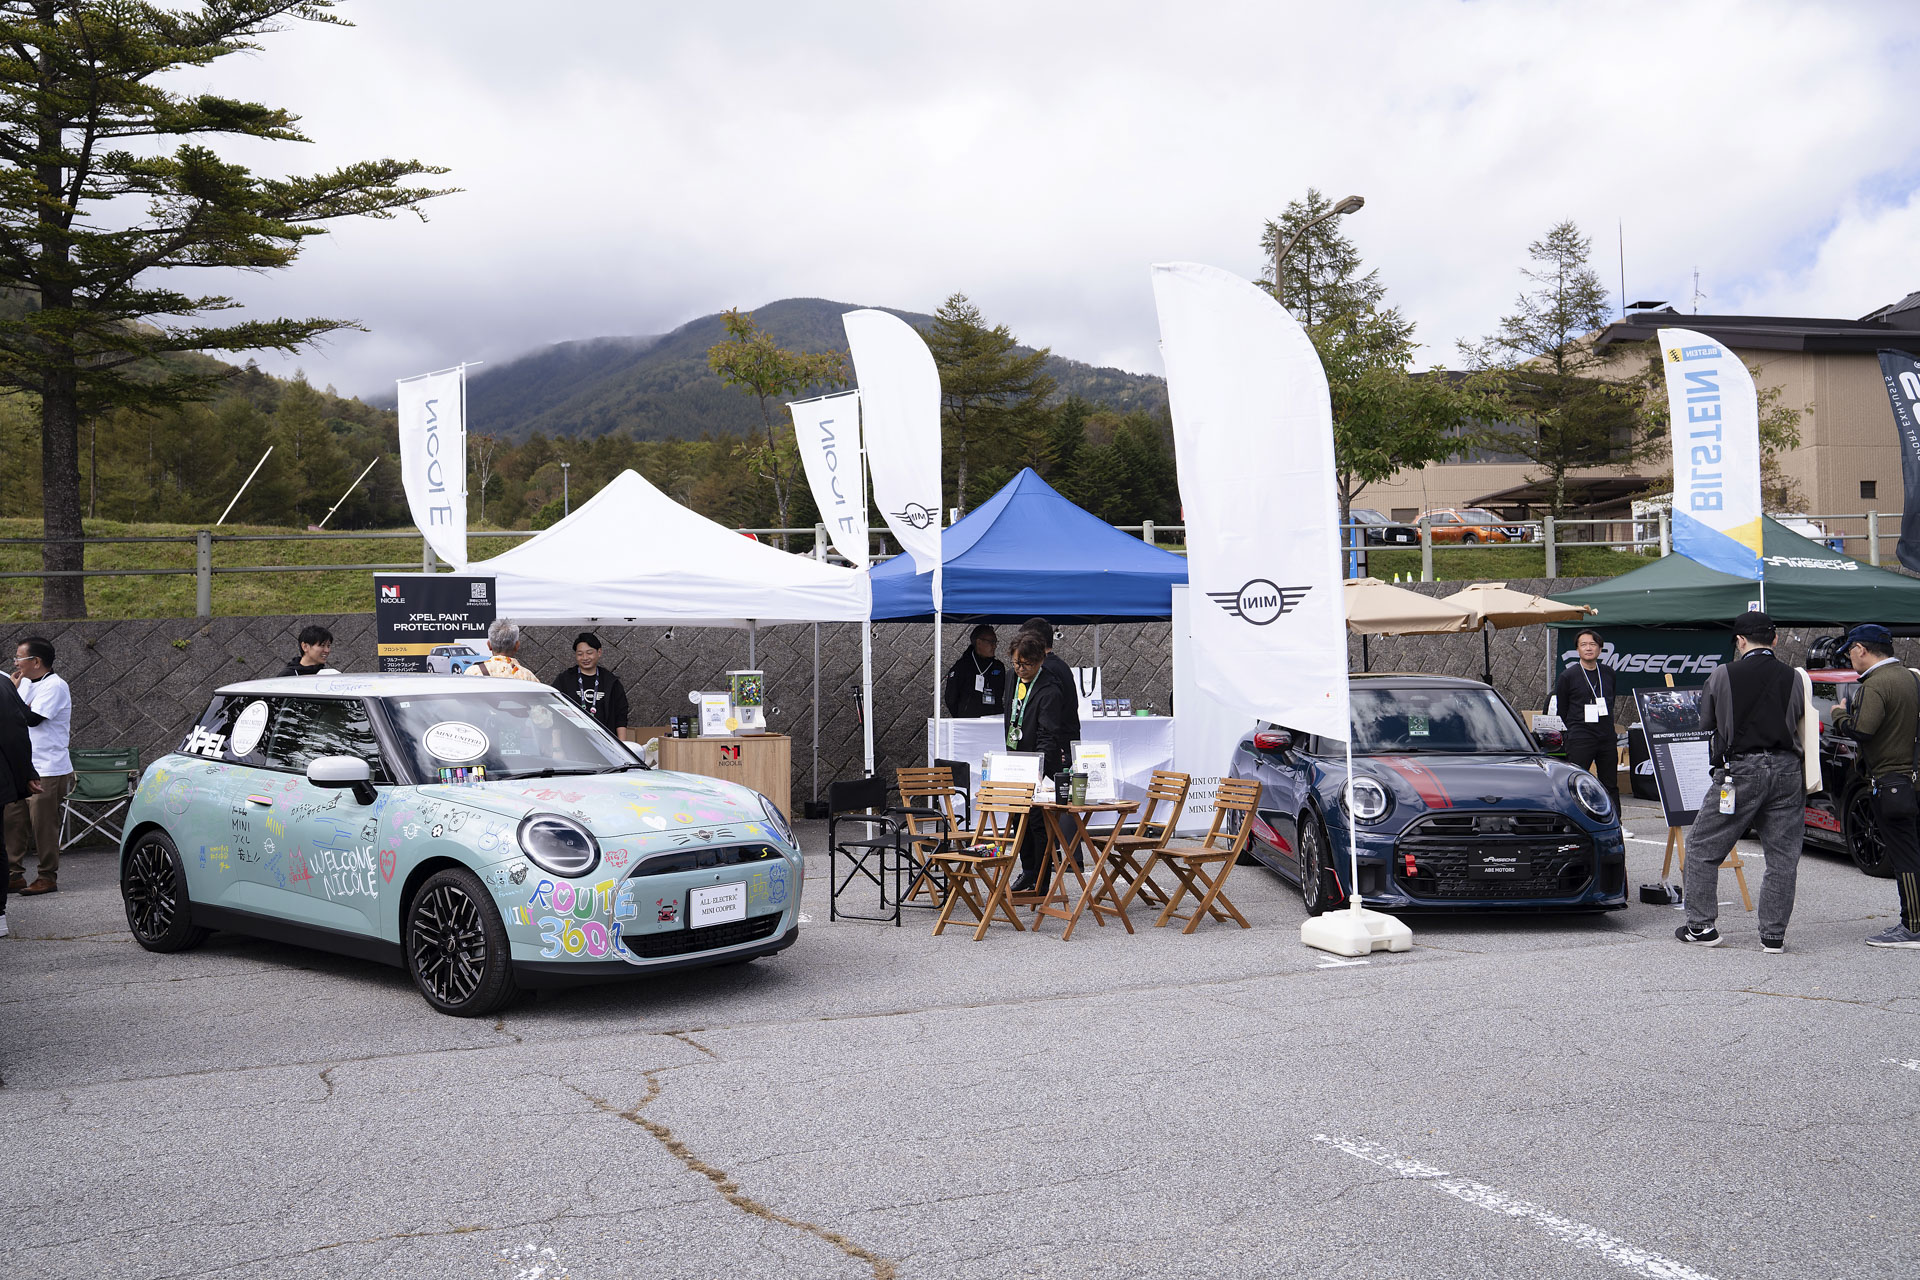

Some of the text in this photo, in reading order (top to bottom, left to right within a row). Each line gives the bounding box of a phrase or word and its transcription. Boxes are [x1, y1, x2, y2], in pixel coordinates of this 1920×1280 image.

[409, 613, 469, 621] XPEL PAINT
[393, 623, 485, 631] PROTECTION FILM
[434, 730, 453, 738] MINI
[183, 725, 226, 759] XPEL
[1188, 791, 1206, 800] MINI
[1188, 805, 1207, 813] MINI
[231, 818, 251, 832] MINI
[1806, 812, 1836, 827] SECHS
[265, 815, 285, 840] MINI
[760, 847, 768, 858] S
[309, 845, 378, 875] WELCOME
[323, 870, 379, 901] NICOLE
[527, 878, 638, 922] ROUTE
[504, 905, 537, 926] MINI
[701, 903, 737, 916] MINI COOPER
